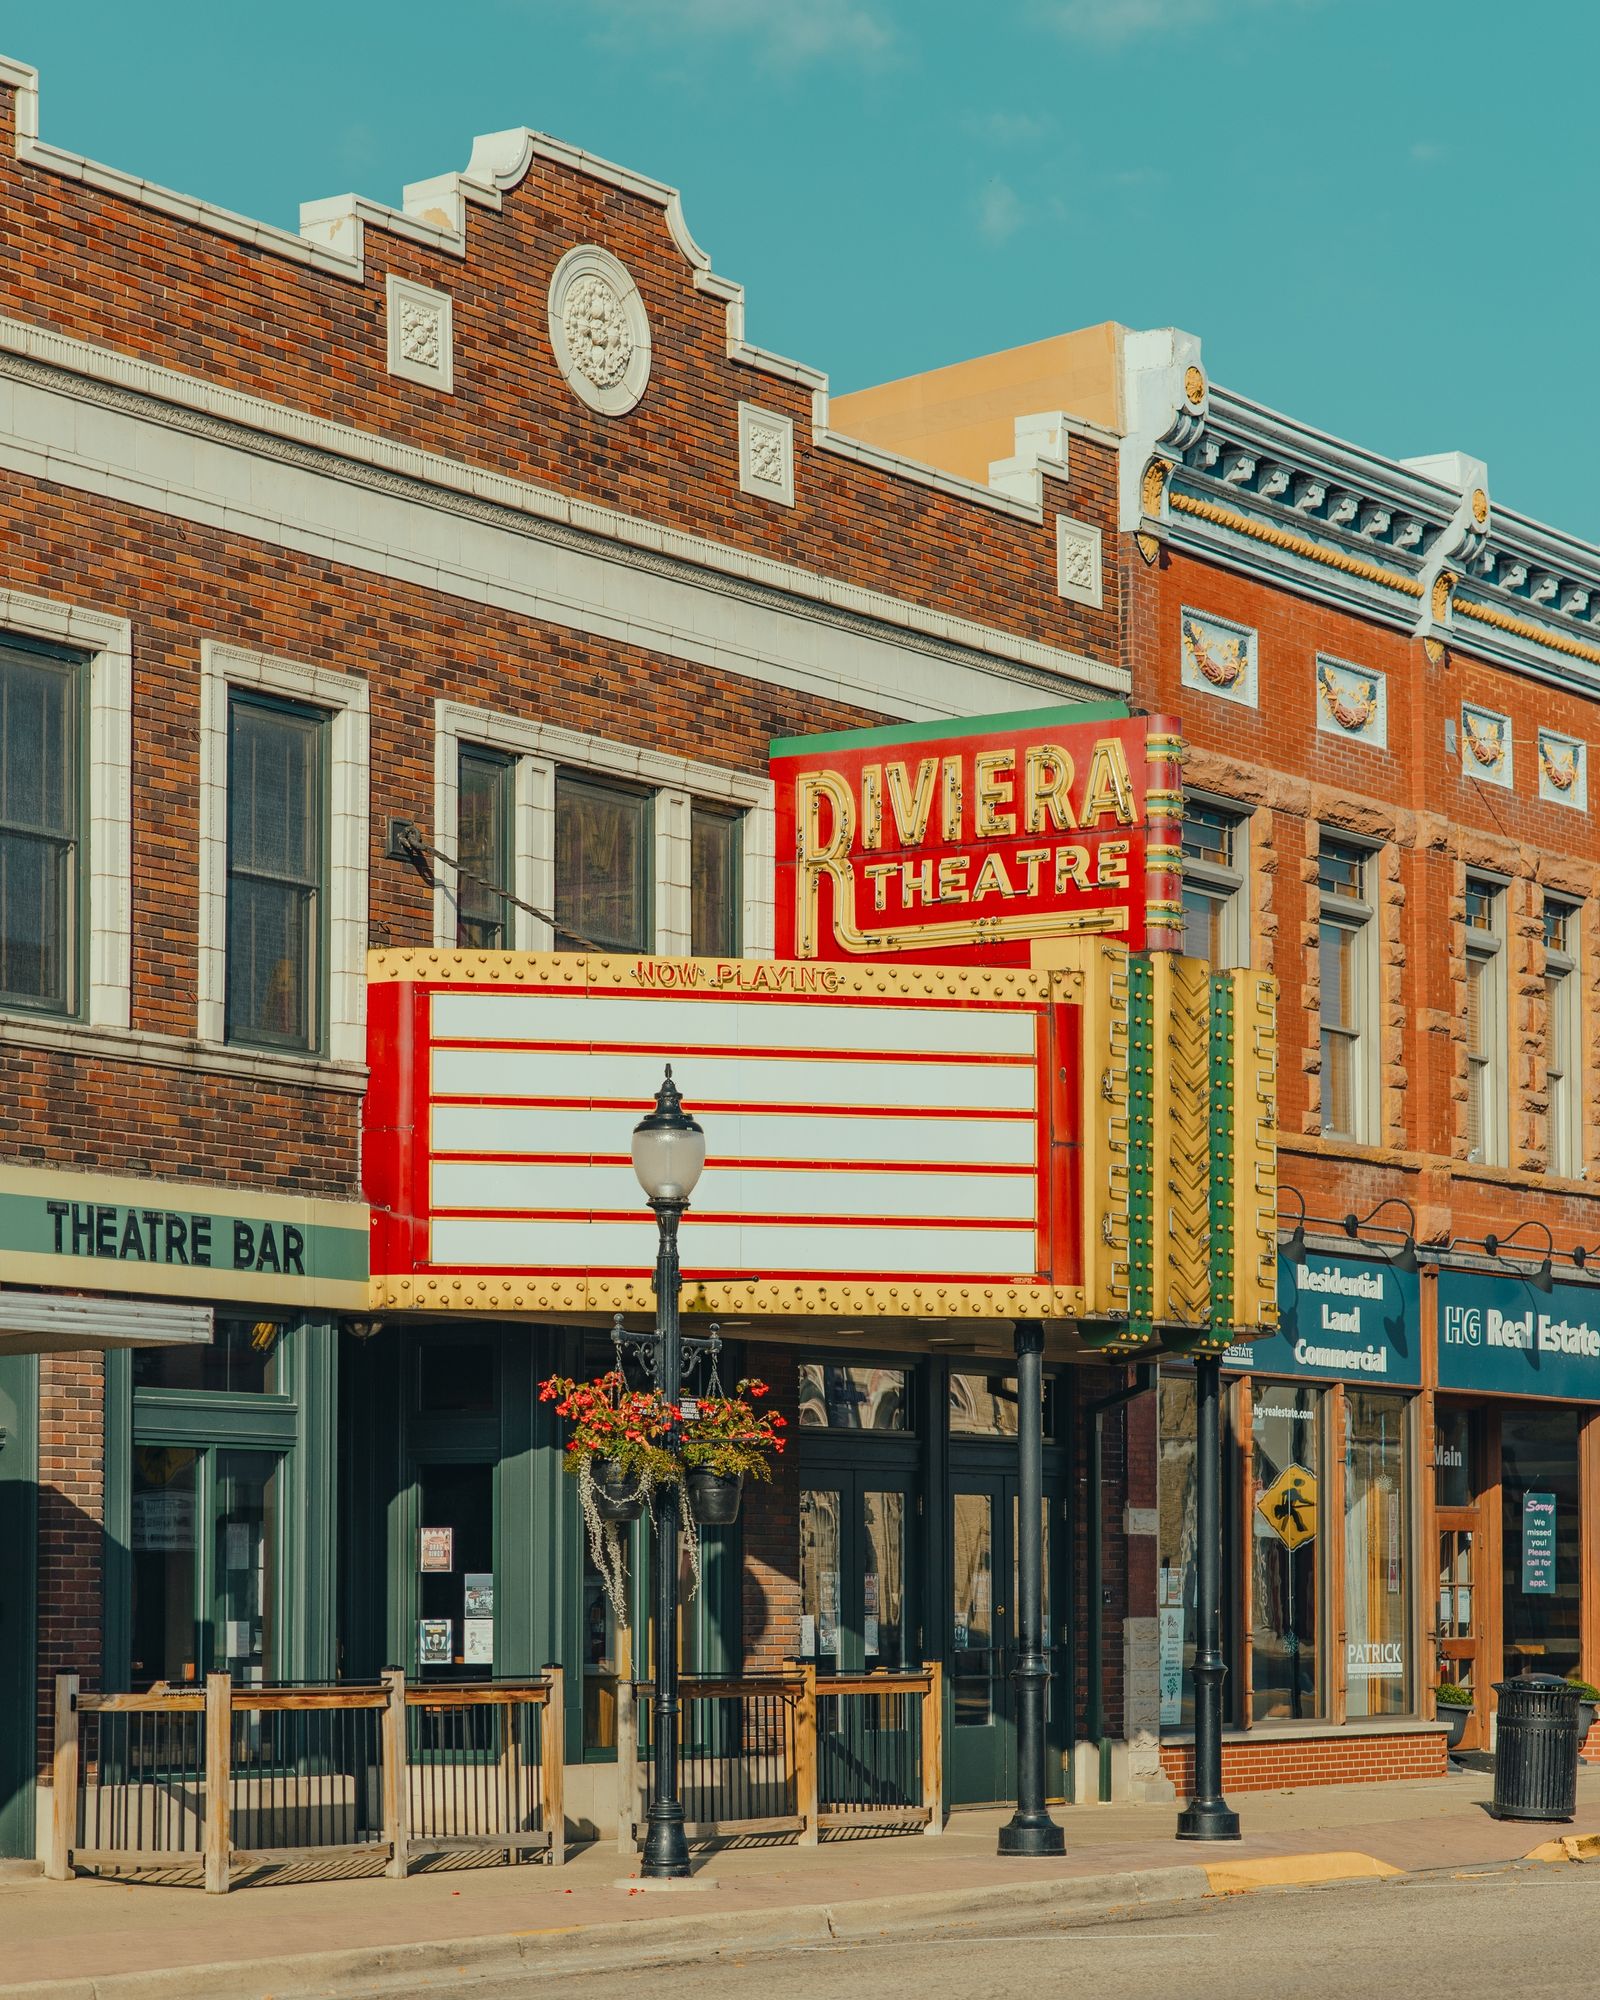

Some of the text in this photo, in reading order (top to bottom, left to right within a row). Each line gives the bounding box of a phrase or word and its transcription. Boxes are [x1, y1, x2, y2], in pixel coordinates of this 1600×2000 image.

[795, 737, 1138, 960] RIVIERA
[864, 841, 1131, 911] THEATRE
[637, 961, 838, 992] NOW PLAYING
[47, 1200, 305, 1275] THEATRE BAR
[1297, 1264, 1383, 1300] Residential
[1322, 1304, 1360, 1333] Land
[1445, 1306, 1600, 1357] HG Real Estate
[1294, 1338, 1387, 1372] Commercial
[1253, 1404, 1314, 1420] hg-realestate.com
[1434, 1444, 1462, 1467] Main
[1525, 1500, 1554, 1514] Sorry
[1527, 1529, 1552, 1537] missed
[1533, 1519, 1546, 1527] We
[1527, 1549, 1551, 1557] Please
[1531, 1540, 1547, 1548] you!
[1527, 1559, 1552, 1567] call for
[1529, 1579, 1548, 1588] appt.
[1348, 1643, 1402, 1663] PATRICK
